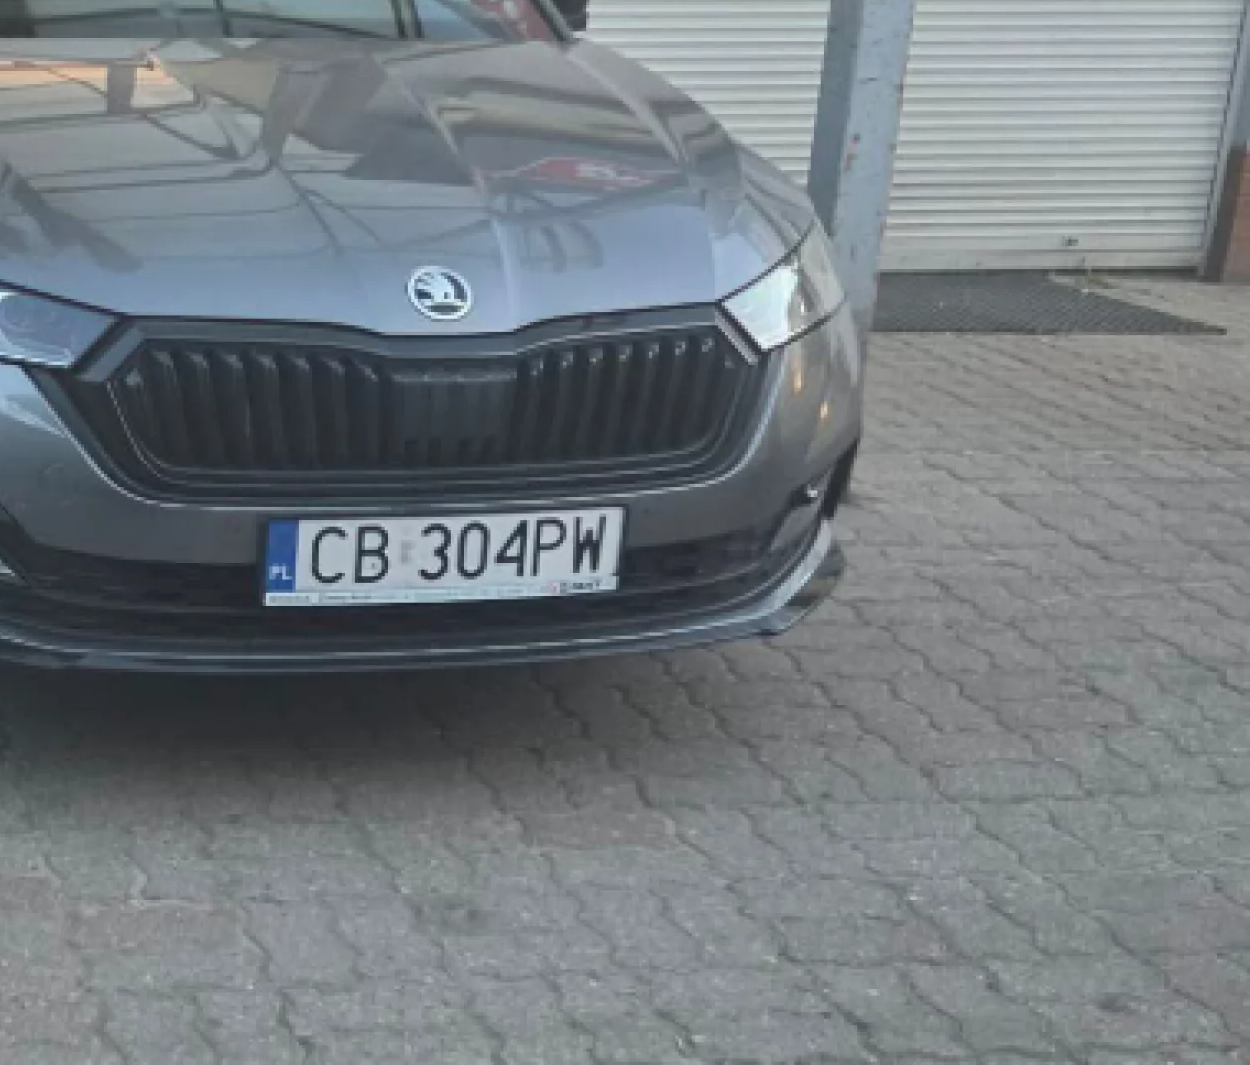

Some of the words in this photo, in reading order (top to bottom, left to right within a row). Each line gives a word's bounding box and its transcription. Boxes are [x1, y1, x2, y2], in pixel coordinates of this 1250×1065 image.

[311, 525, 389, 584] CB
[418, 516, 608, 580] 304PW
[268, 563, 293, 580] PL
